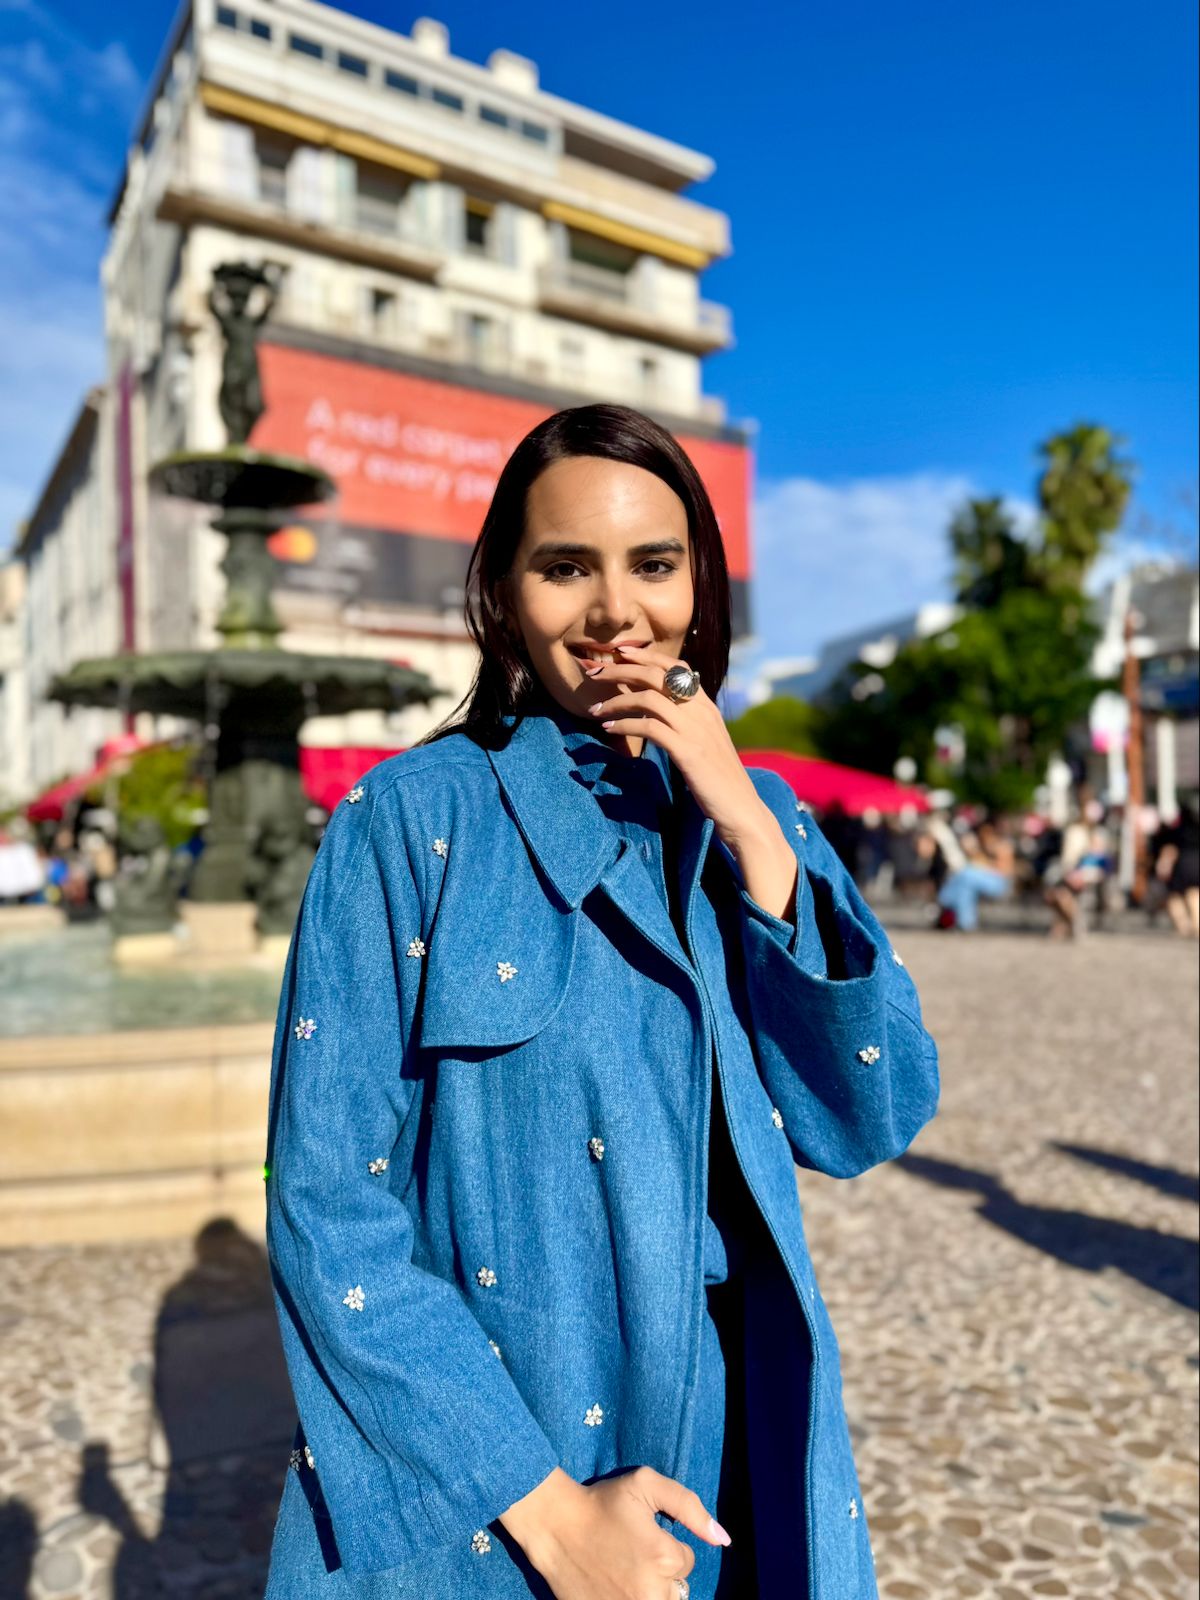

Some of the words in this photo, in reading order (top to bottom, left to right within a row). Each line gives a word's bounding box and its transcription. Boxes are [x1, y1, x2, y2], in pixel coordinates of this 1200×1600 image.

[306, 398, 335, 431] A
[340, 411, 398, 448] red
[307, 435, 358, 474] for
[363, 452, 452, 500] every
